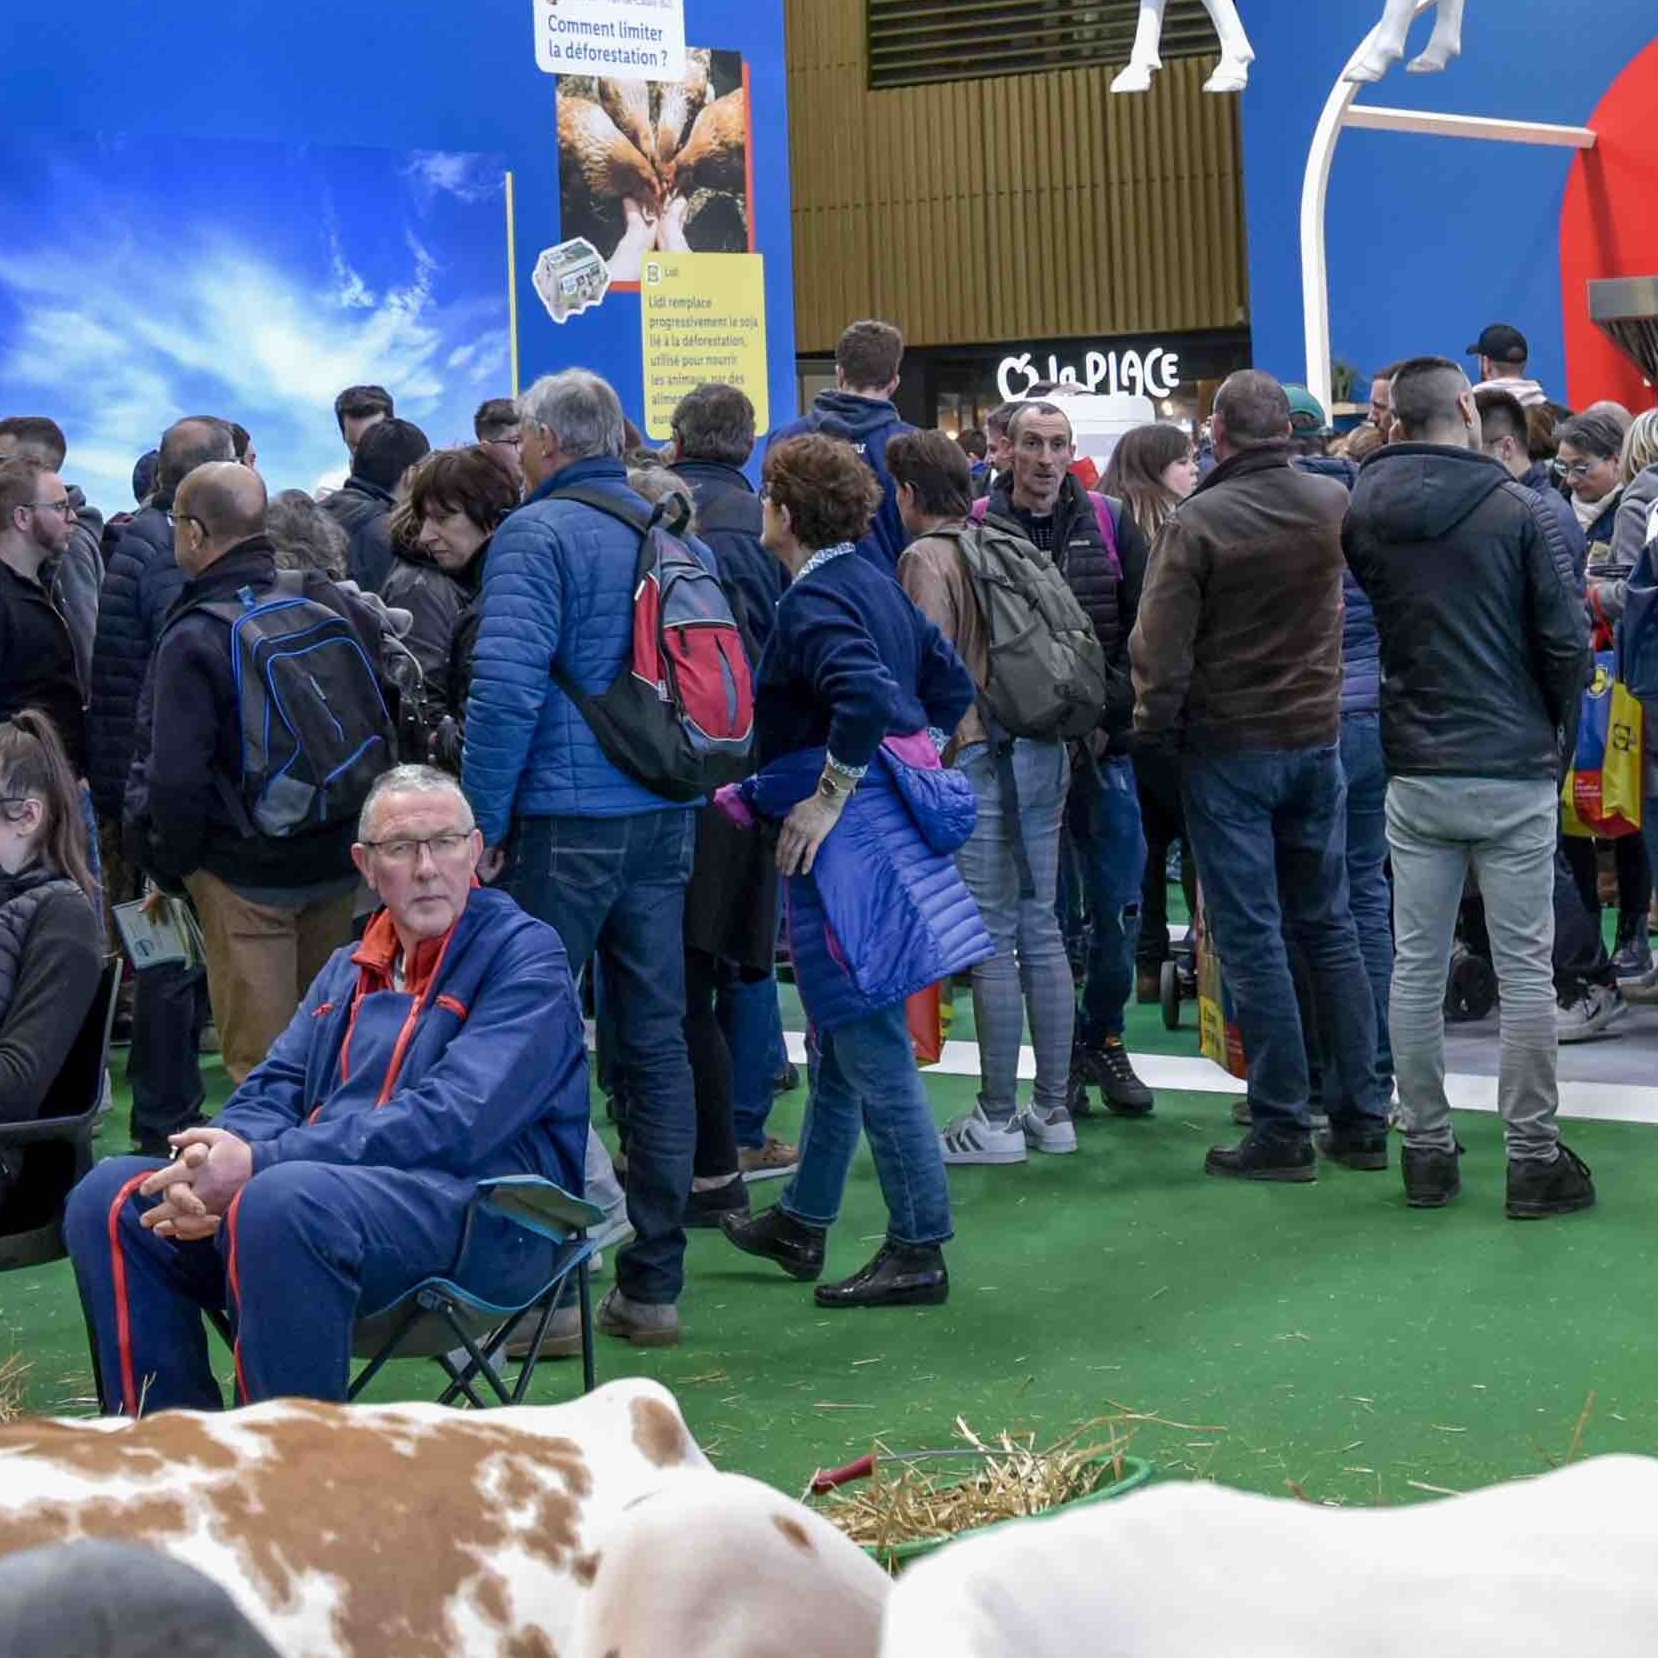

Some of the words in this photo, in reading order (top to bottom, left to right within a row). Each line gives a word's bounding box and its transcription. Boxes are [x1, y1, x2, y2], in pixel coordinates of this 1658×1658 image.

[548, 14, 615, 38] Comment
[619, 21, 663, 42] limiter
[549, 39, 562, 59] la
[565, 39, 658, 67] déforestation
[661, 49, 669, 68] ?
[648, 294, 666, 309] Lidl
[669, 295, 712, 312] remplace
[649, 315, 727, 331] progressivement
[682, 356, 703, 370] pour
[1086, 347, 1180, 398] PLACE
